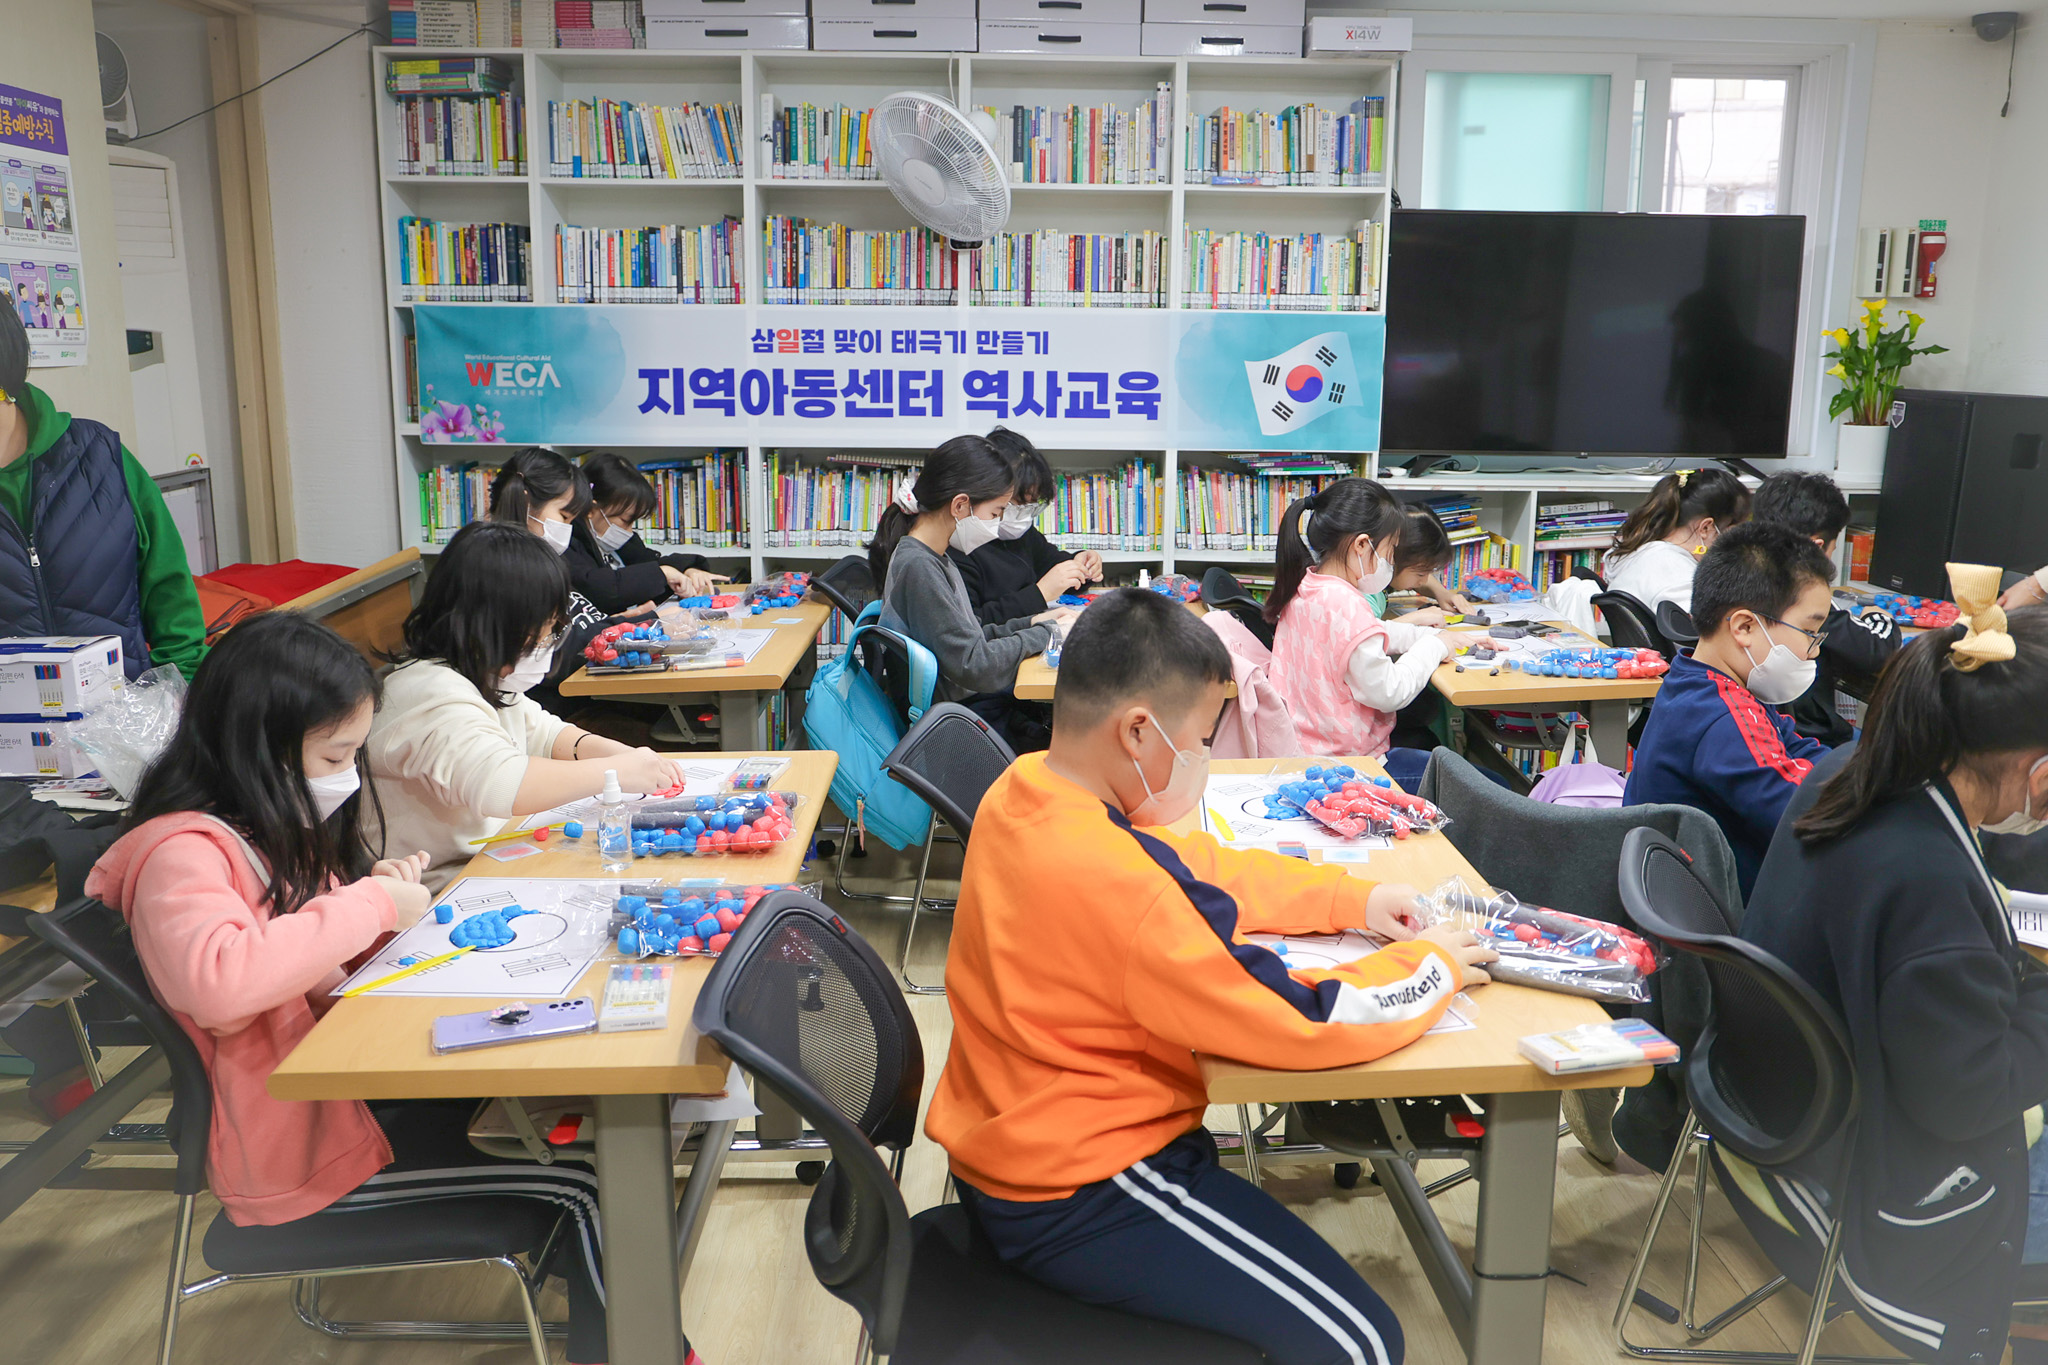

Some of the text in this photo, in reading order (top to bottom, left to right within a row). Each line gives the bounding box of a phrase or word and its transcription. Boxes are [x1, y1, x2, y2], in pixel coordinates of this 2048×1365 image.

[750, 328, 1049, 355] 삼일절 맞이 태극기 만들기
[465, 362, 562, 388] WECA
[637, 368, 1162, 421] 지역아동센터 역사교육
